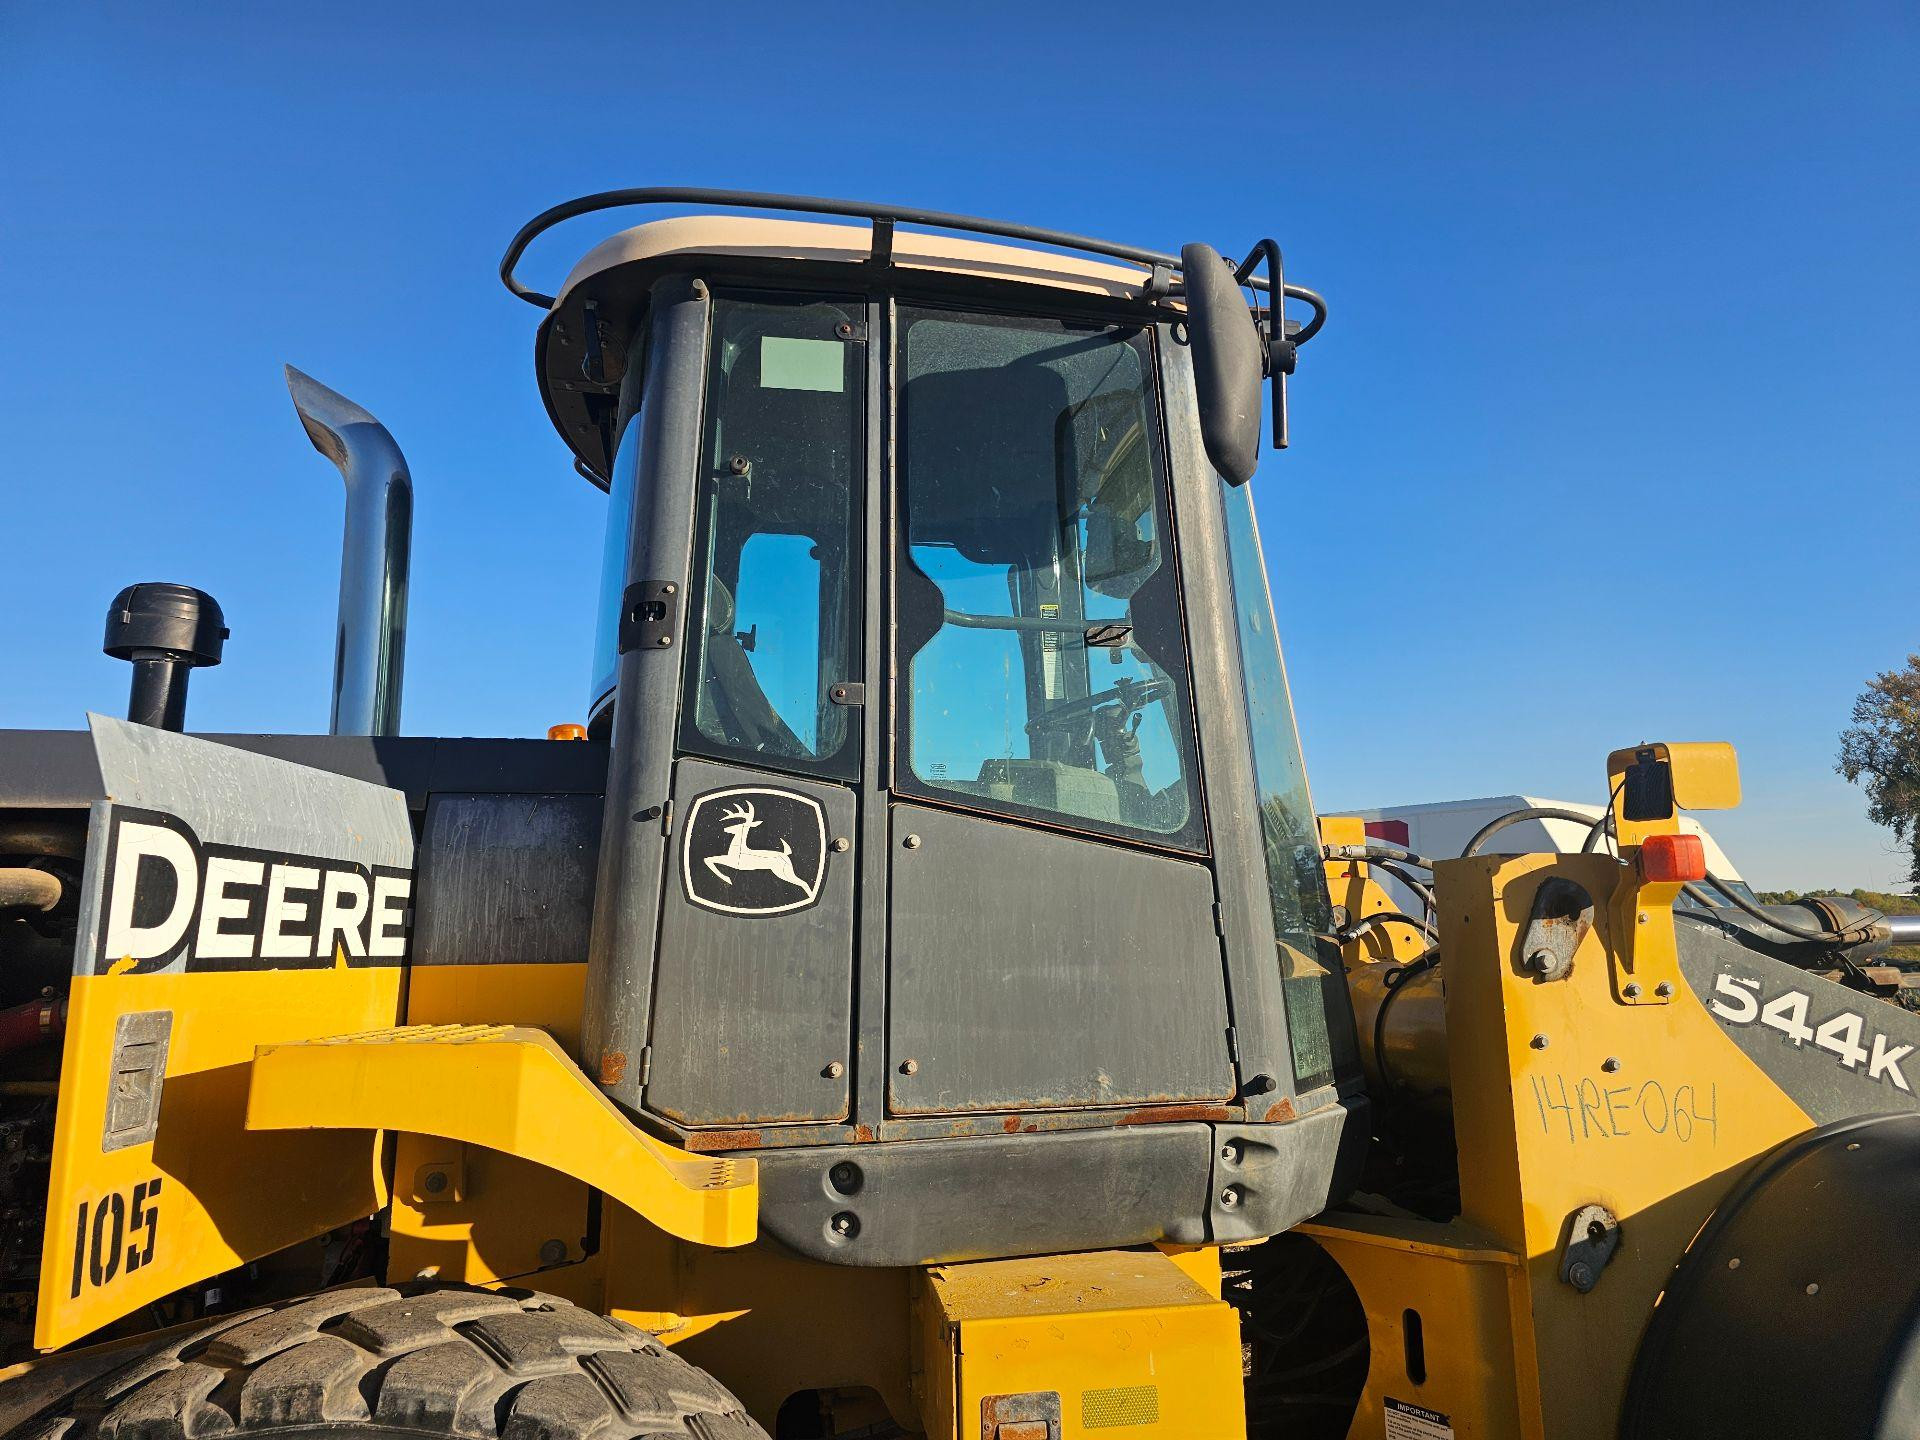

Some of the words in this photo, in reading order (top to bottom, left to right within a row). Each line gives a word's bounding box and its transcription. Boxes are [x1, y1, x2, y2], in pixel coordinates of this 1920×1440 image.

[105, 820, 412, 961] DEERE
[1711, 973, 1914, 1090] 544K
[71, 1178, 162, 1300] 105
[1397, 1403, 1440, 1422] IMPORTANT
